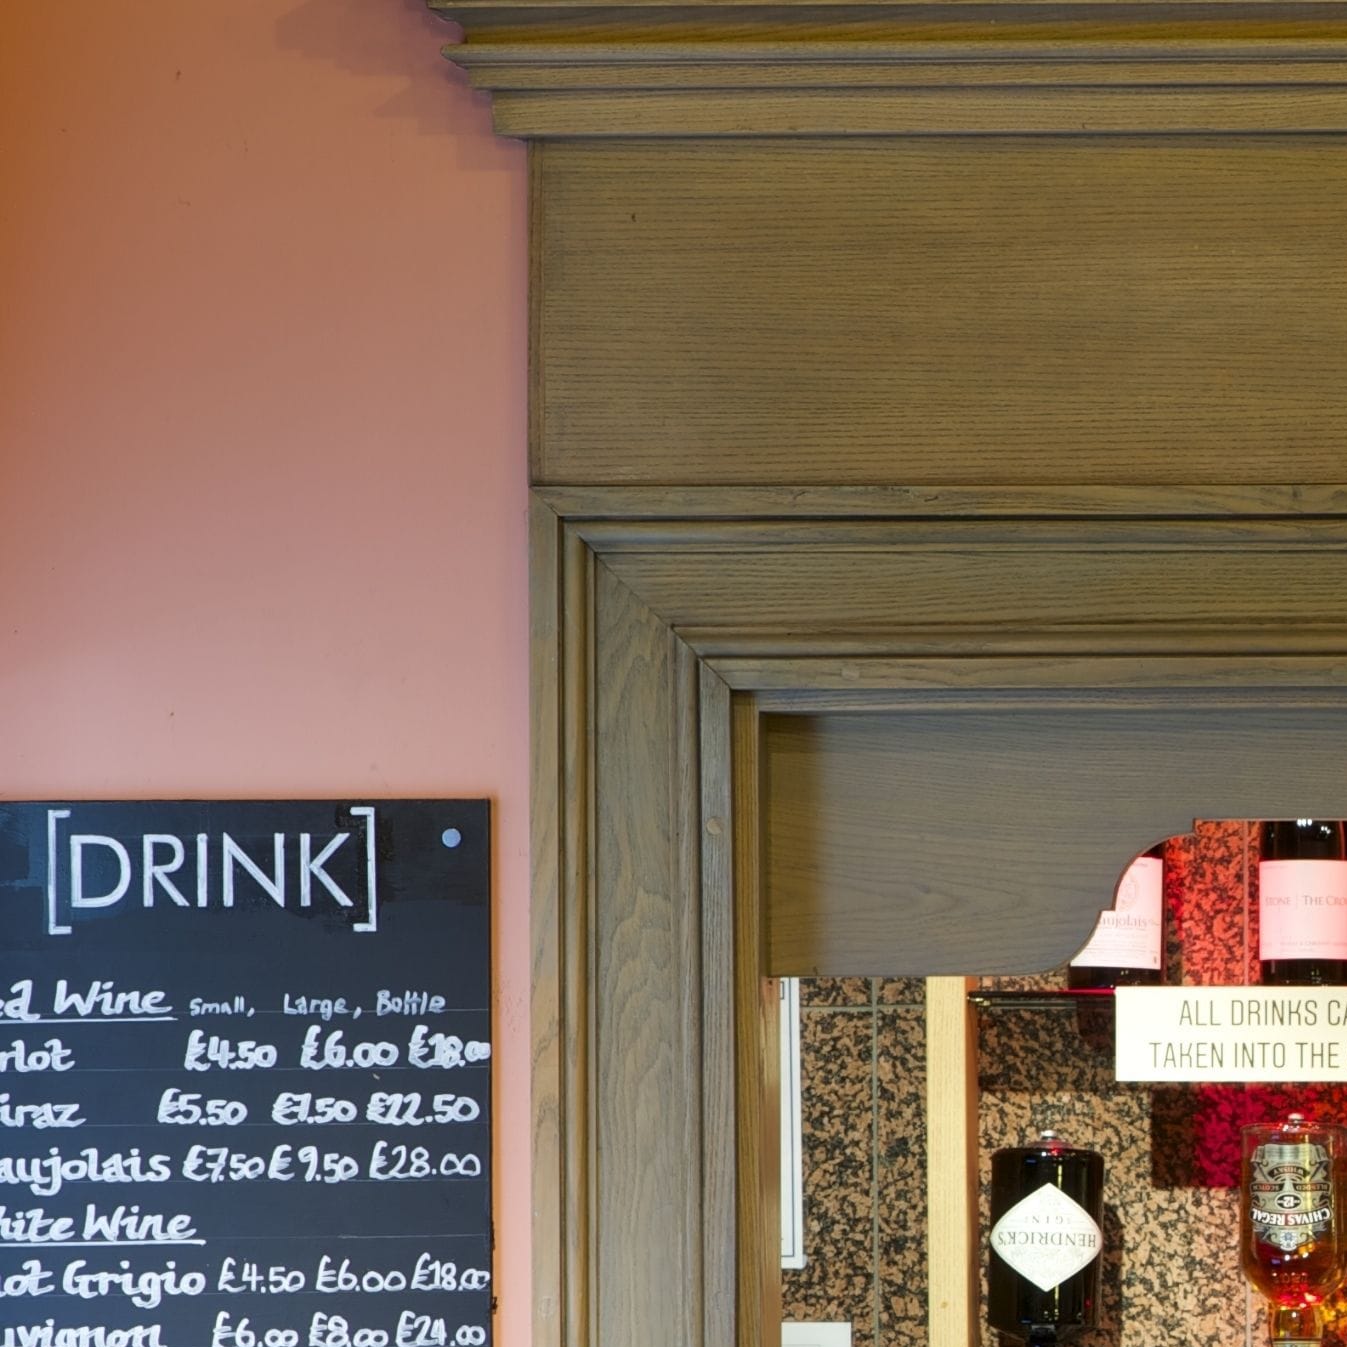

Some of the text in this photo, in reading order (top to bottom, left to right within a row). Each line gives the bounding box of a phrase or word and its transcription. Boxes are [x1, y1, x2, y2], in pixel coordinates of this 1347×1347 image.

[376, 990, 446, 1016] Bottle
[1179, 1001, 1220, 1026] ALL
[1231, 1001, 1318, 1026] DRINKS
[184, 1025, 399, 1070] £4.50 £6.00
[1150, 1042, 1224, 1069] TAKEN
[1234, 1042, 1286, 1069] INTO
[1296, 1042, 1340, 1069] THE
[158, 1089, 247, 1124] £5.50
[268, 1140, 481, 1182] £9.50 £28.00
[83, 1204, 197, 1241] Wine
[1252, 1208, 1330, 1225] CHIVAS REGAL
[998, 1232, 1096, 1247] HENDRICK'S
[62, 1255, 406, 1308] Grigio £4.50 £6.00
